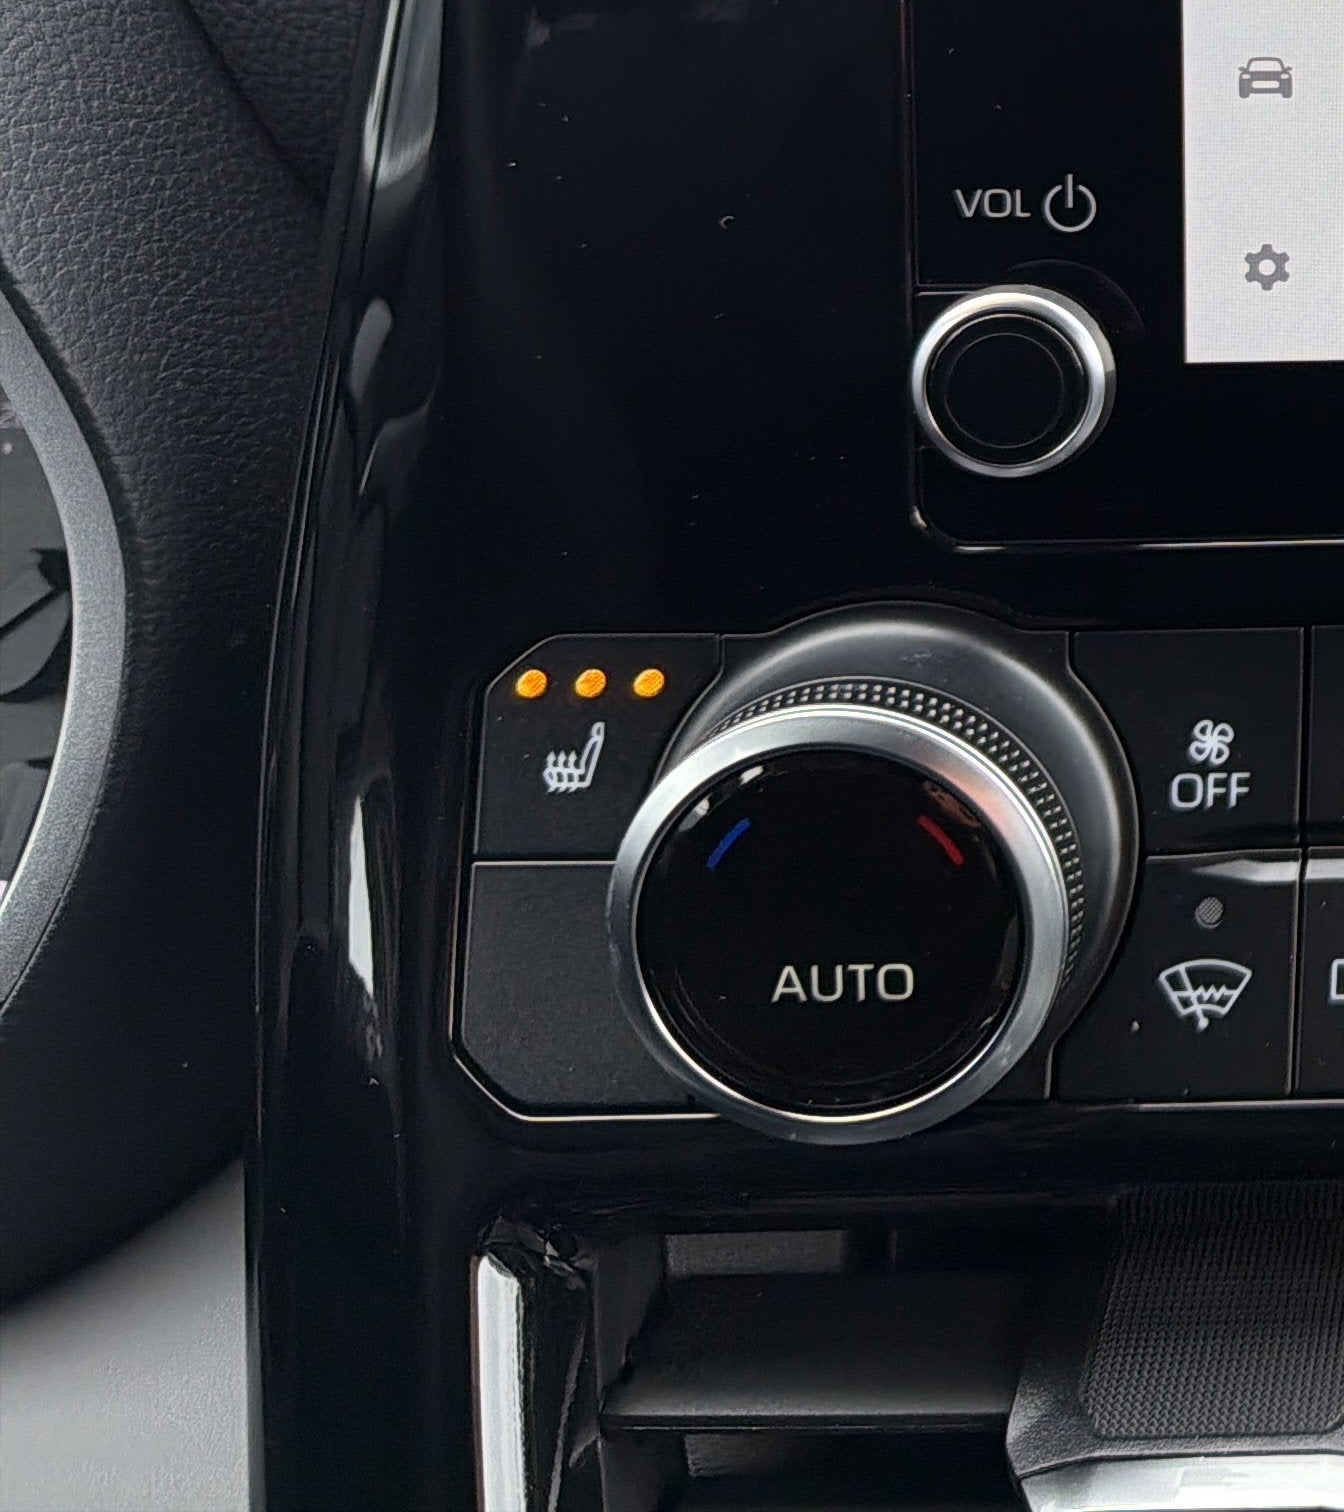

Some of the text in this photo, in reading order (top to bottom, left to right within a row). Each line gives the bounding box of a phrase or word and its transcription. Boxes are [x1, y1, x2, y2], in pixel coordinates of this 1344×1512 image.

[953, 188, 1032, 218] VOL
[1169, 770, 1251, 810] OFF
[770, 962, 915, 1003] AUTO
